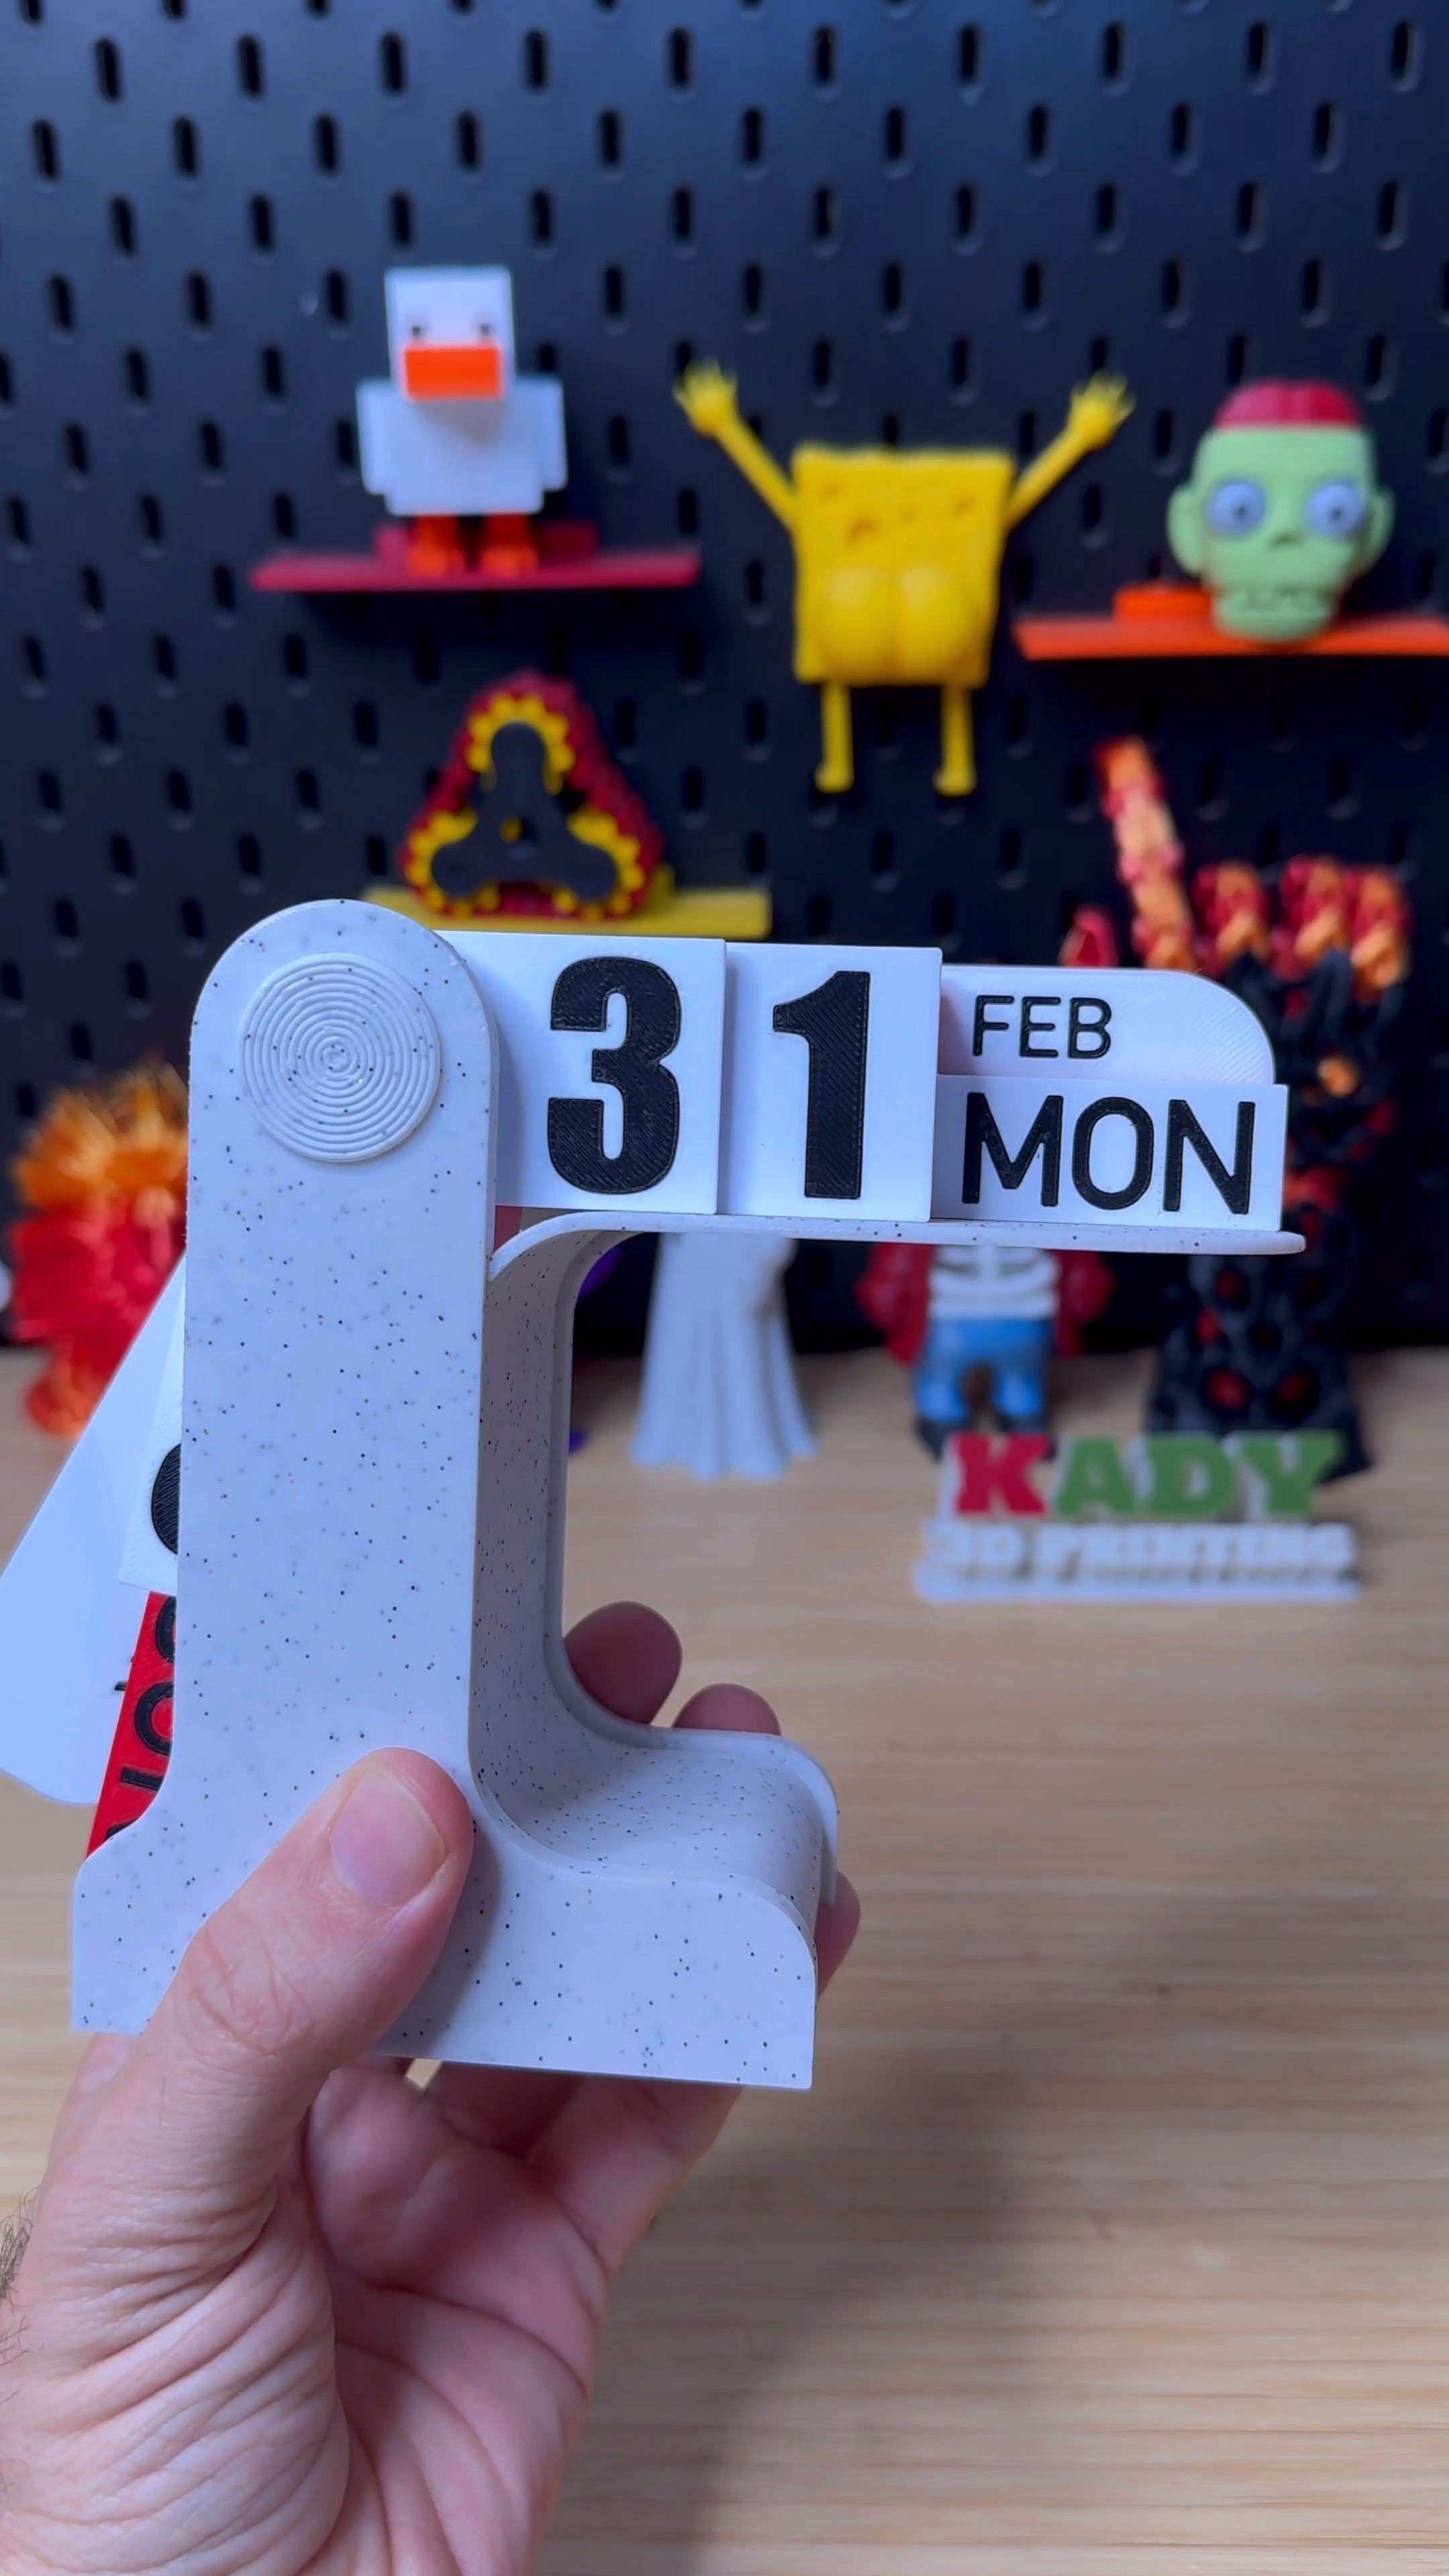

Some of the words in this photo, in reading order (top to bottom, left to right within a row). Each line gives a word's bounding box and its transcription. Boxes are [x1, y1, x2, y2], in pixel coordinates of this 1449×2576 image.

[971, 994, 1113, 1060] FEB
[961, 1091, 1256, 1216] MON
[951, 1430, 1342, 1517] KADY
[1030, 1520, 1356, 1571] PRINTING
